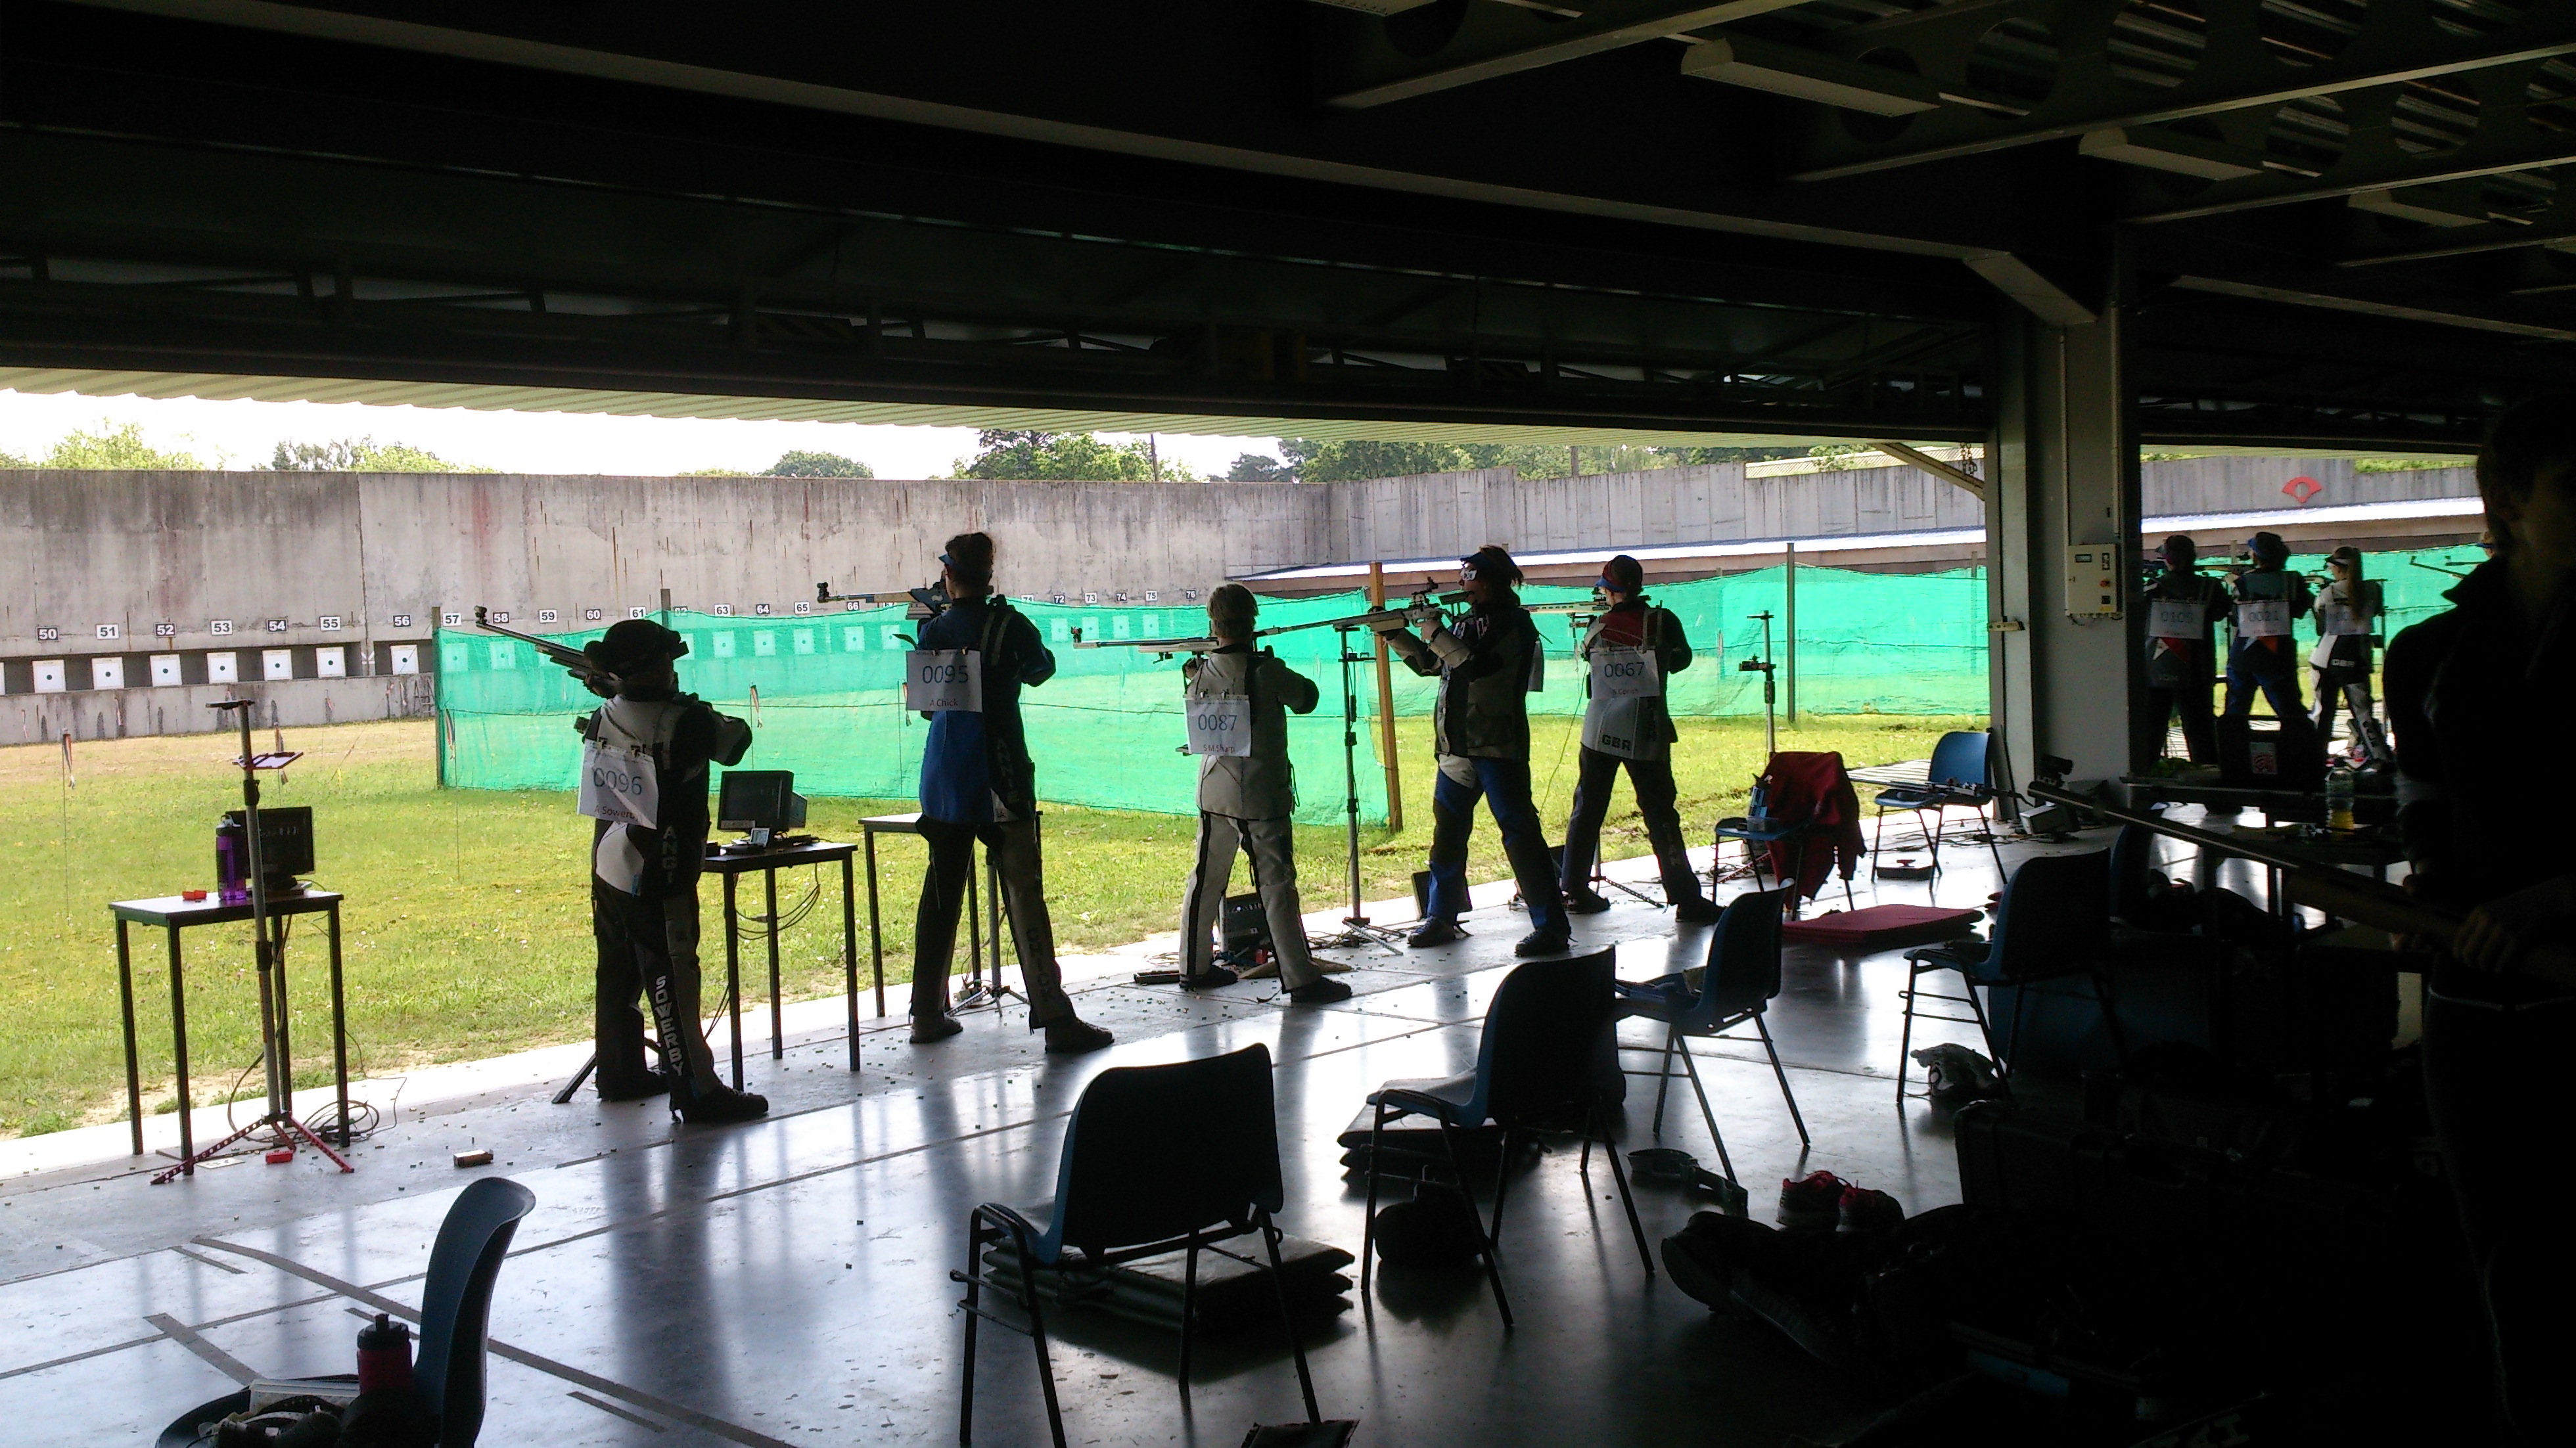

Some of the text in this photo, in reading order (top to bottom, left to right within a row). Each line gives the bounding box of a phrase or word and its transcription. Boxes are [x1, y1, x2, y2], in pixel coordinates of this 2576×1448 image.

[716, 606, 729, 615] 63
[756, 605, 770, 614] 64
[796, 603, 808, 612] 65
[847, 602, 859, 610] 66
[494, 613, 509, 622] 58
[541, 612, 555, 621] 59
[586, 610, 601, 620] 60
[632, 609, 644, 618] 61
[323, 618, 338, 629] 55
[394, 616, 410, 626] 56
[445, 615, 459, 624] 57
[156, 624, 175, 635] 52
[214, 622, 230, 633] 53
[269, 621, 285, 631] 54
[39, 628, 57, 640] 50
[100, 627, 116, 637] 51
[922, 665, 969, 683] 0095
[1604, 662, 1645, 677] 0067
[936, 698, 958, 707] Chick
[1198, 713, 1237, 731] 0087
[1602, 735, 1631, 751] GBR
[1216, 744, 1235, 754] Sharp
[593, 767, 643, 796] 0096
[654, 975, 684, 1077] SOWERBY
